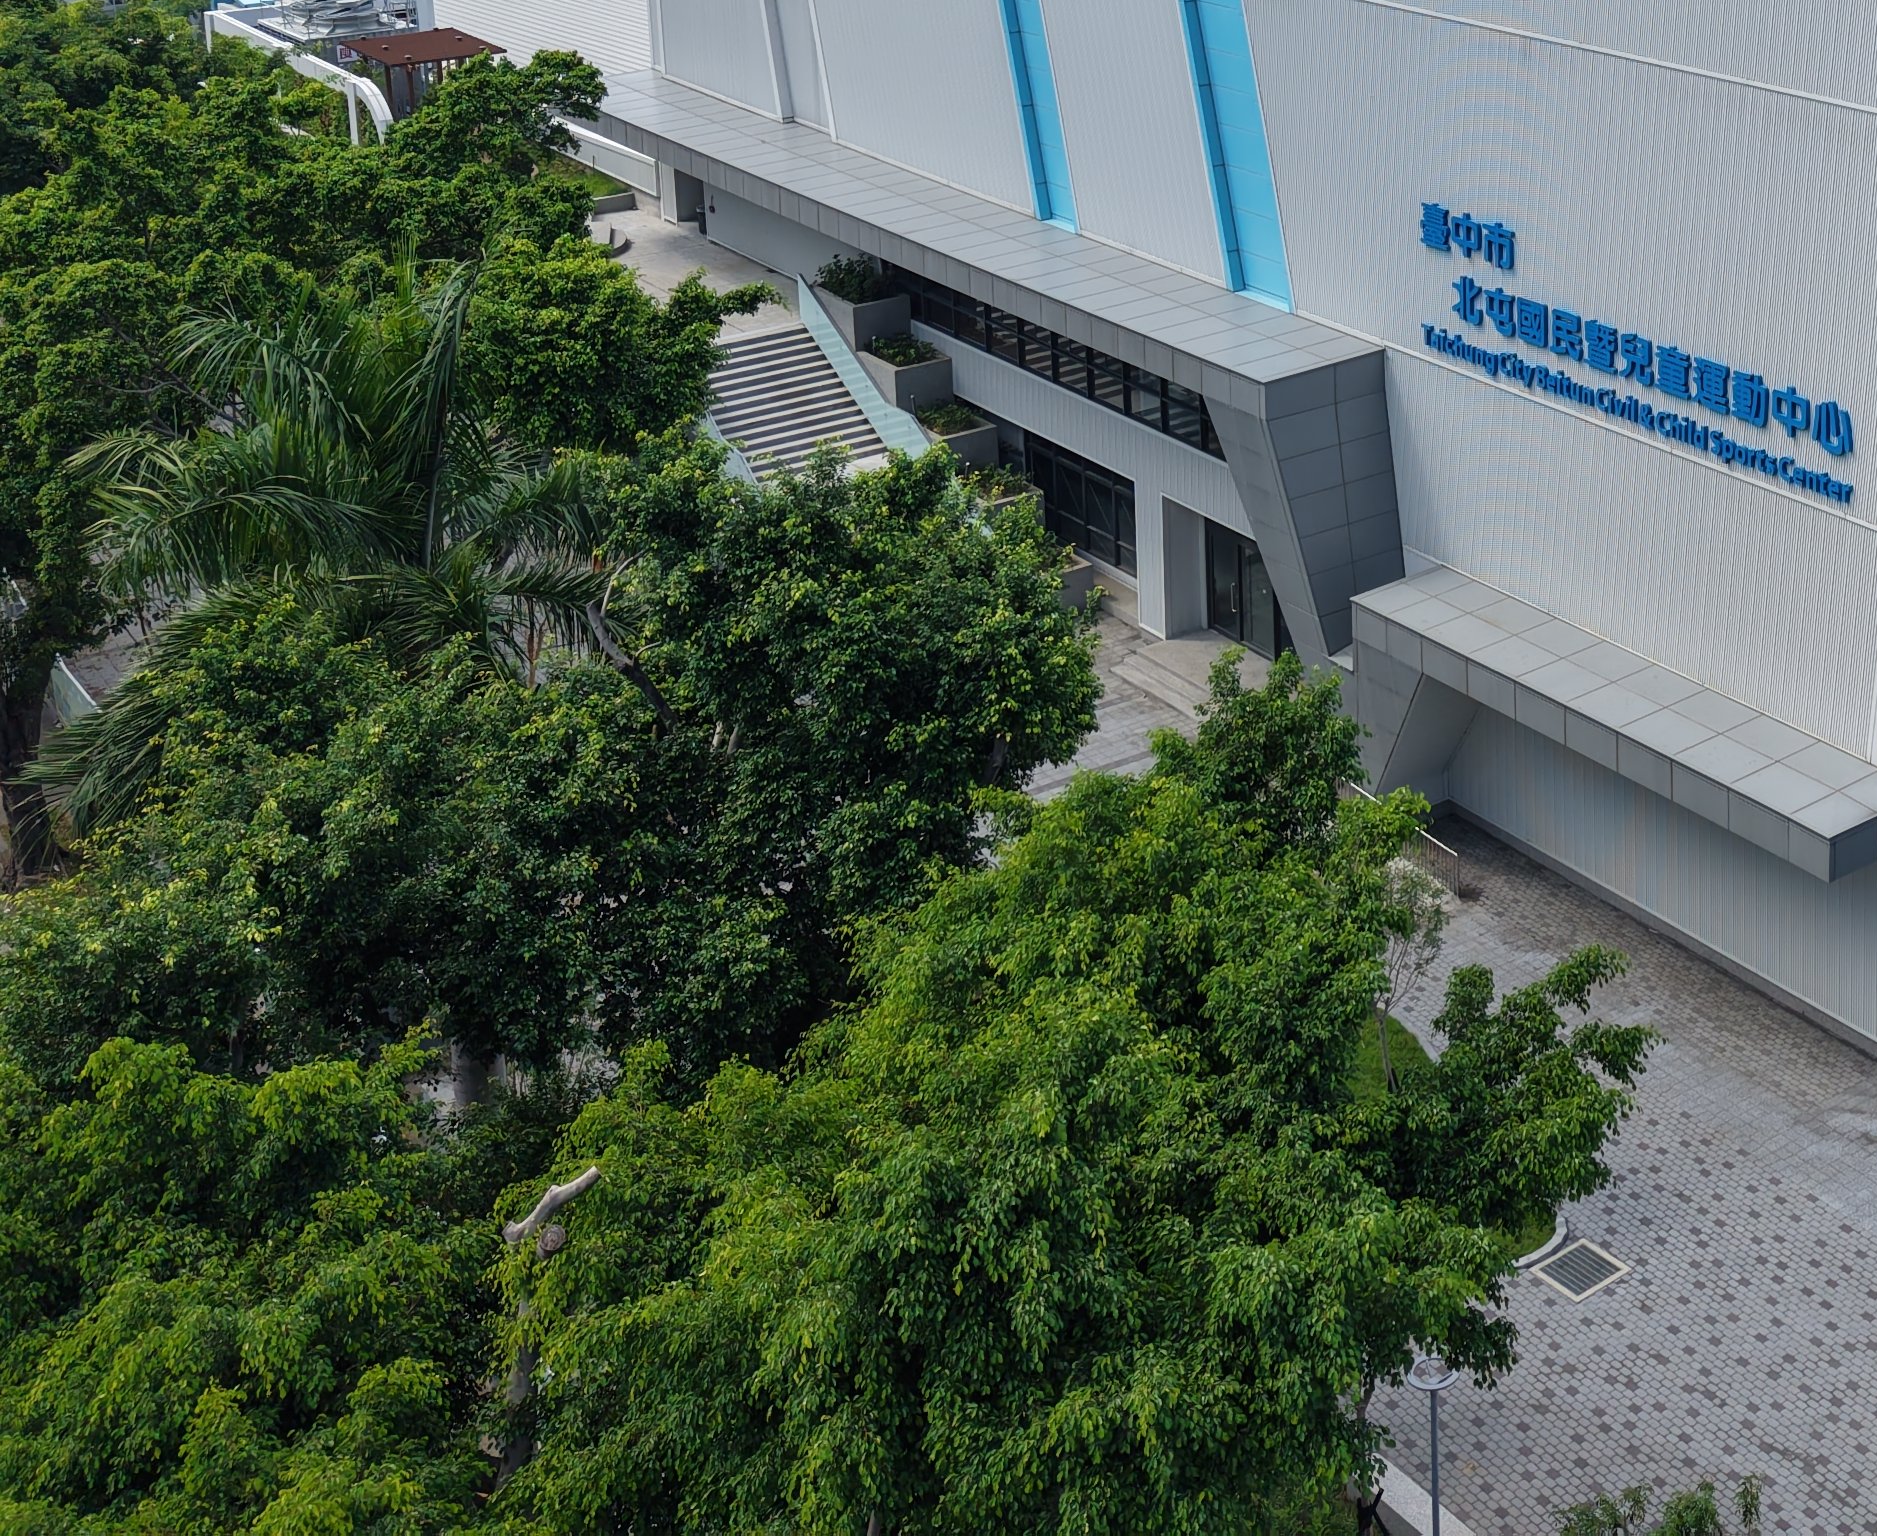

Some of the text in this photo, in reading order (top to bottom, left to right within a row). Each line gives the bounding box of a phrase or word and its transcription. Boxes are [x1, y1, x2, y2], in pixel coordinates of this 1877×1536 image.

[1420, 202, 1516, 270] 臺中市
[1421, 322, 1854, 503] Taichung City Beitun Civil & Child Sports Center
[1452, 275, 1853, 456] 北屯國民暨兒童運動中心
